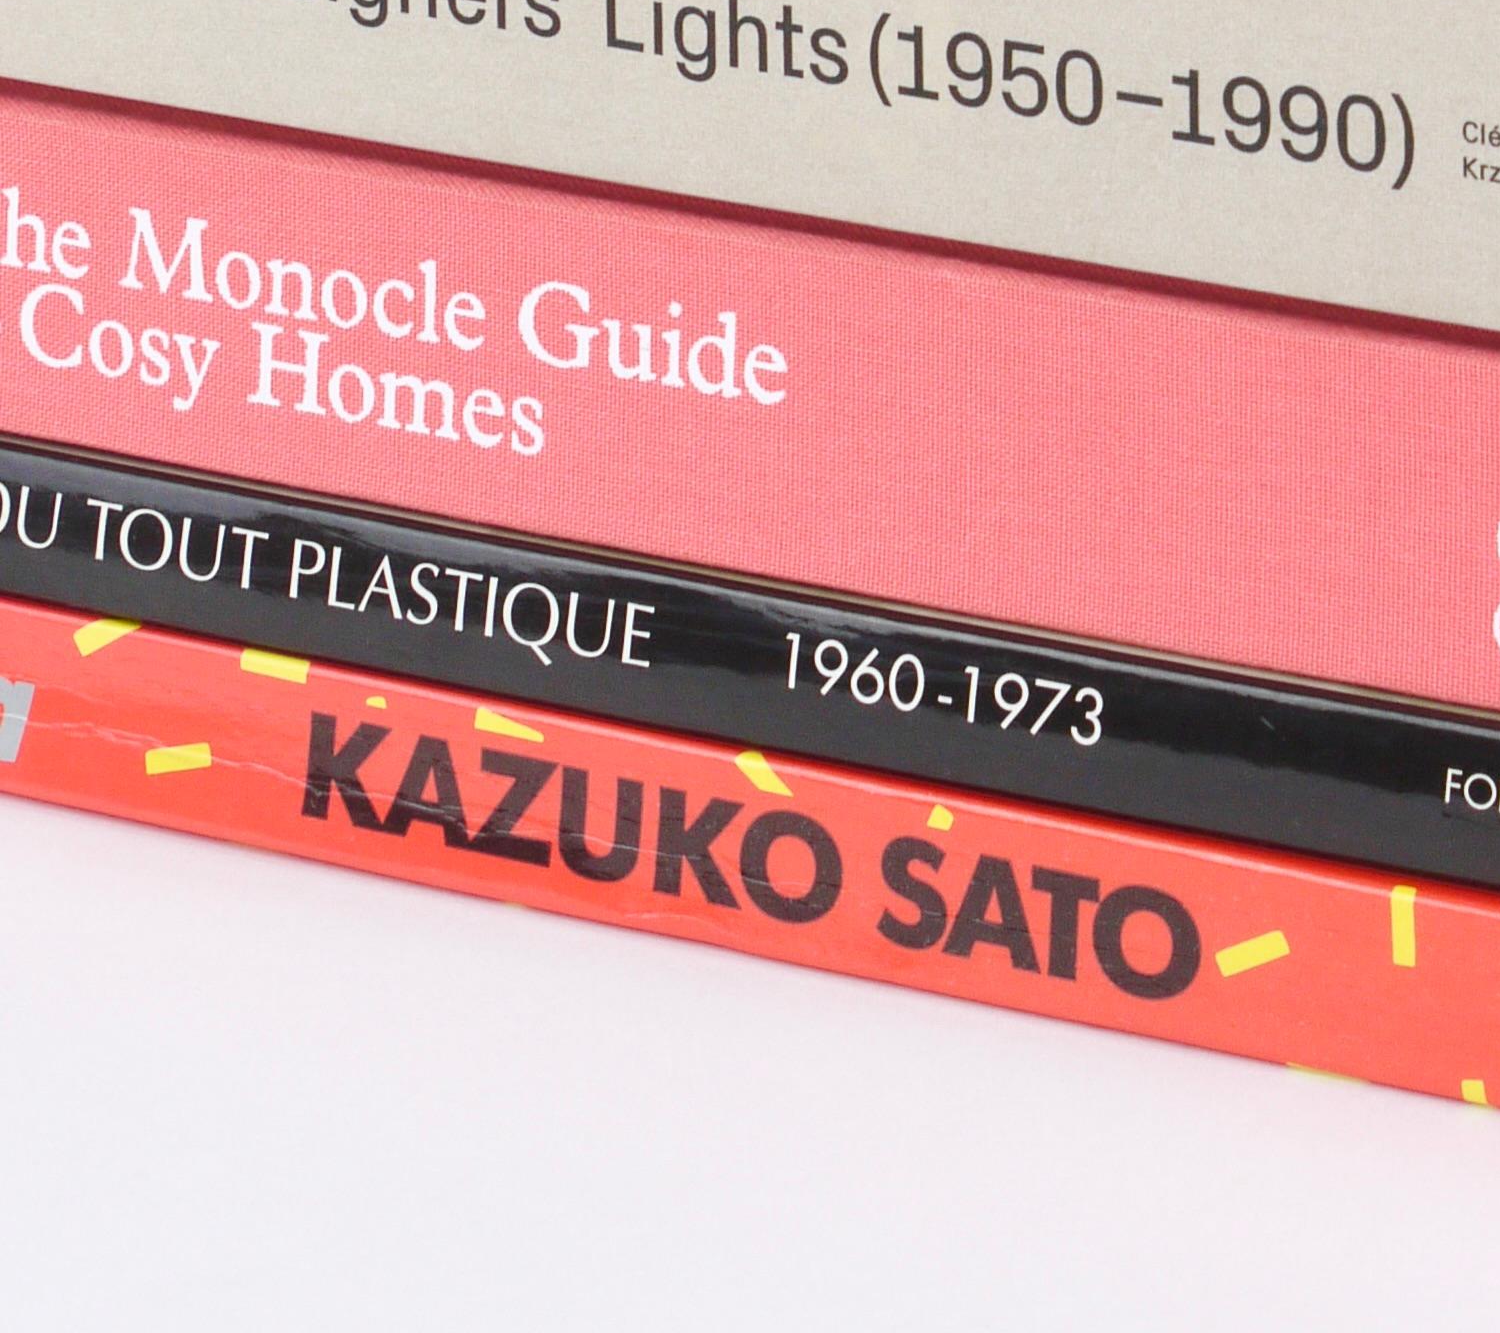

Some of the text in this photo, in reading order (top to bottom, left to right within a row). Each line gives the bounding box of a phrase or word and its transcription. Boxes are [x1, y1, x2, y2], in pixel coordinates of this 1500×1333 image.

[19, 283, 546, 457] Cosy Homes
[118, 206, 487, 351] Monocle
[517, 280, 789, 407] Guide
[86, 496, 271, 591] TOUT
[288, 538, 657, 668] PLASTIQUE
[300, 710, 1203, 1001] KAZUKO SATO
